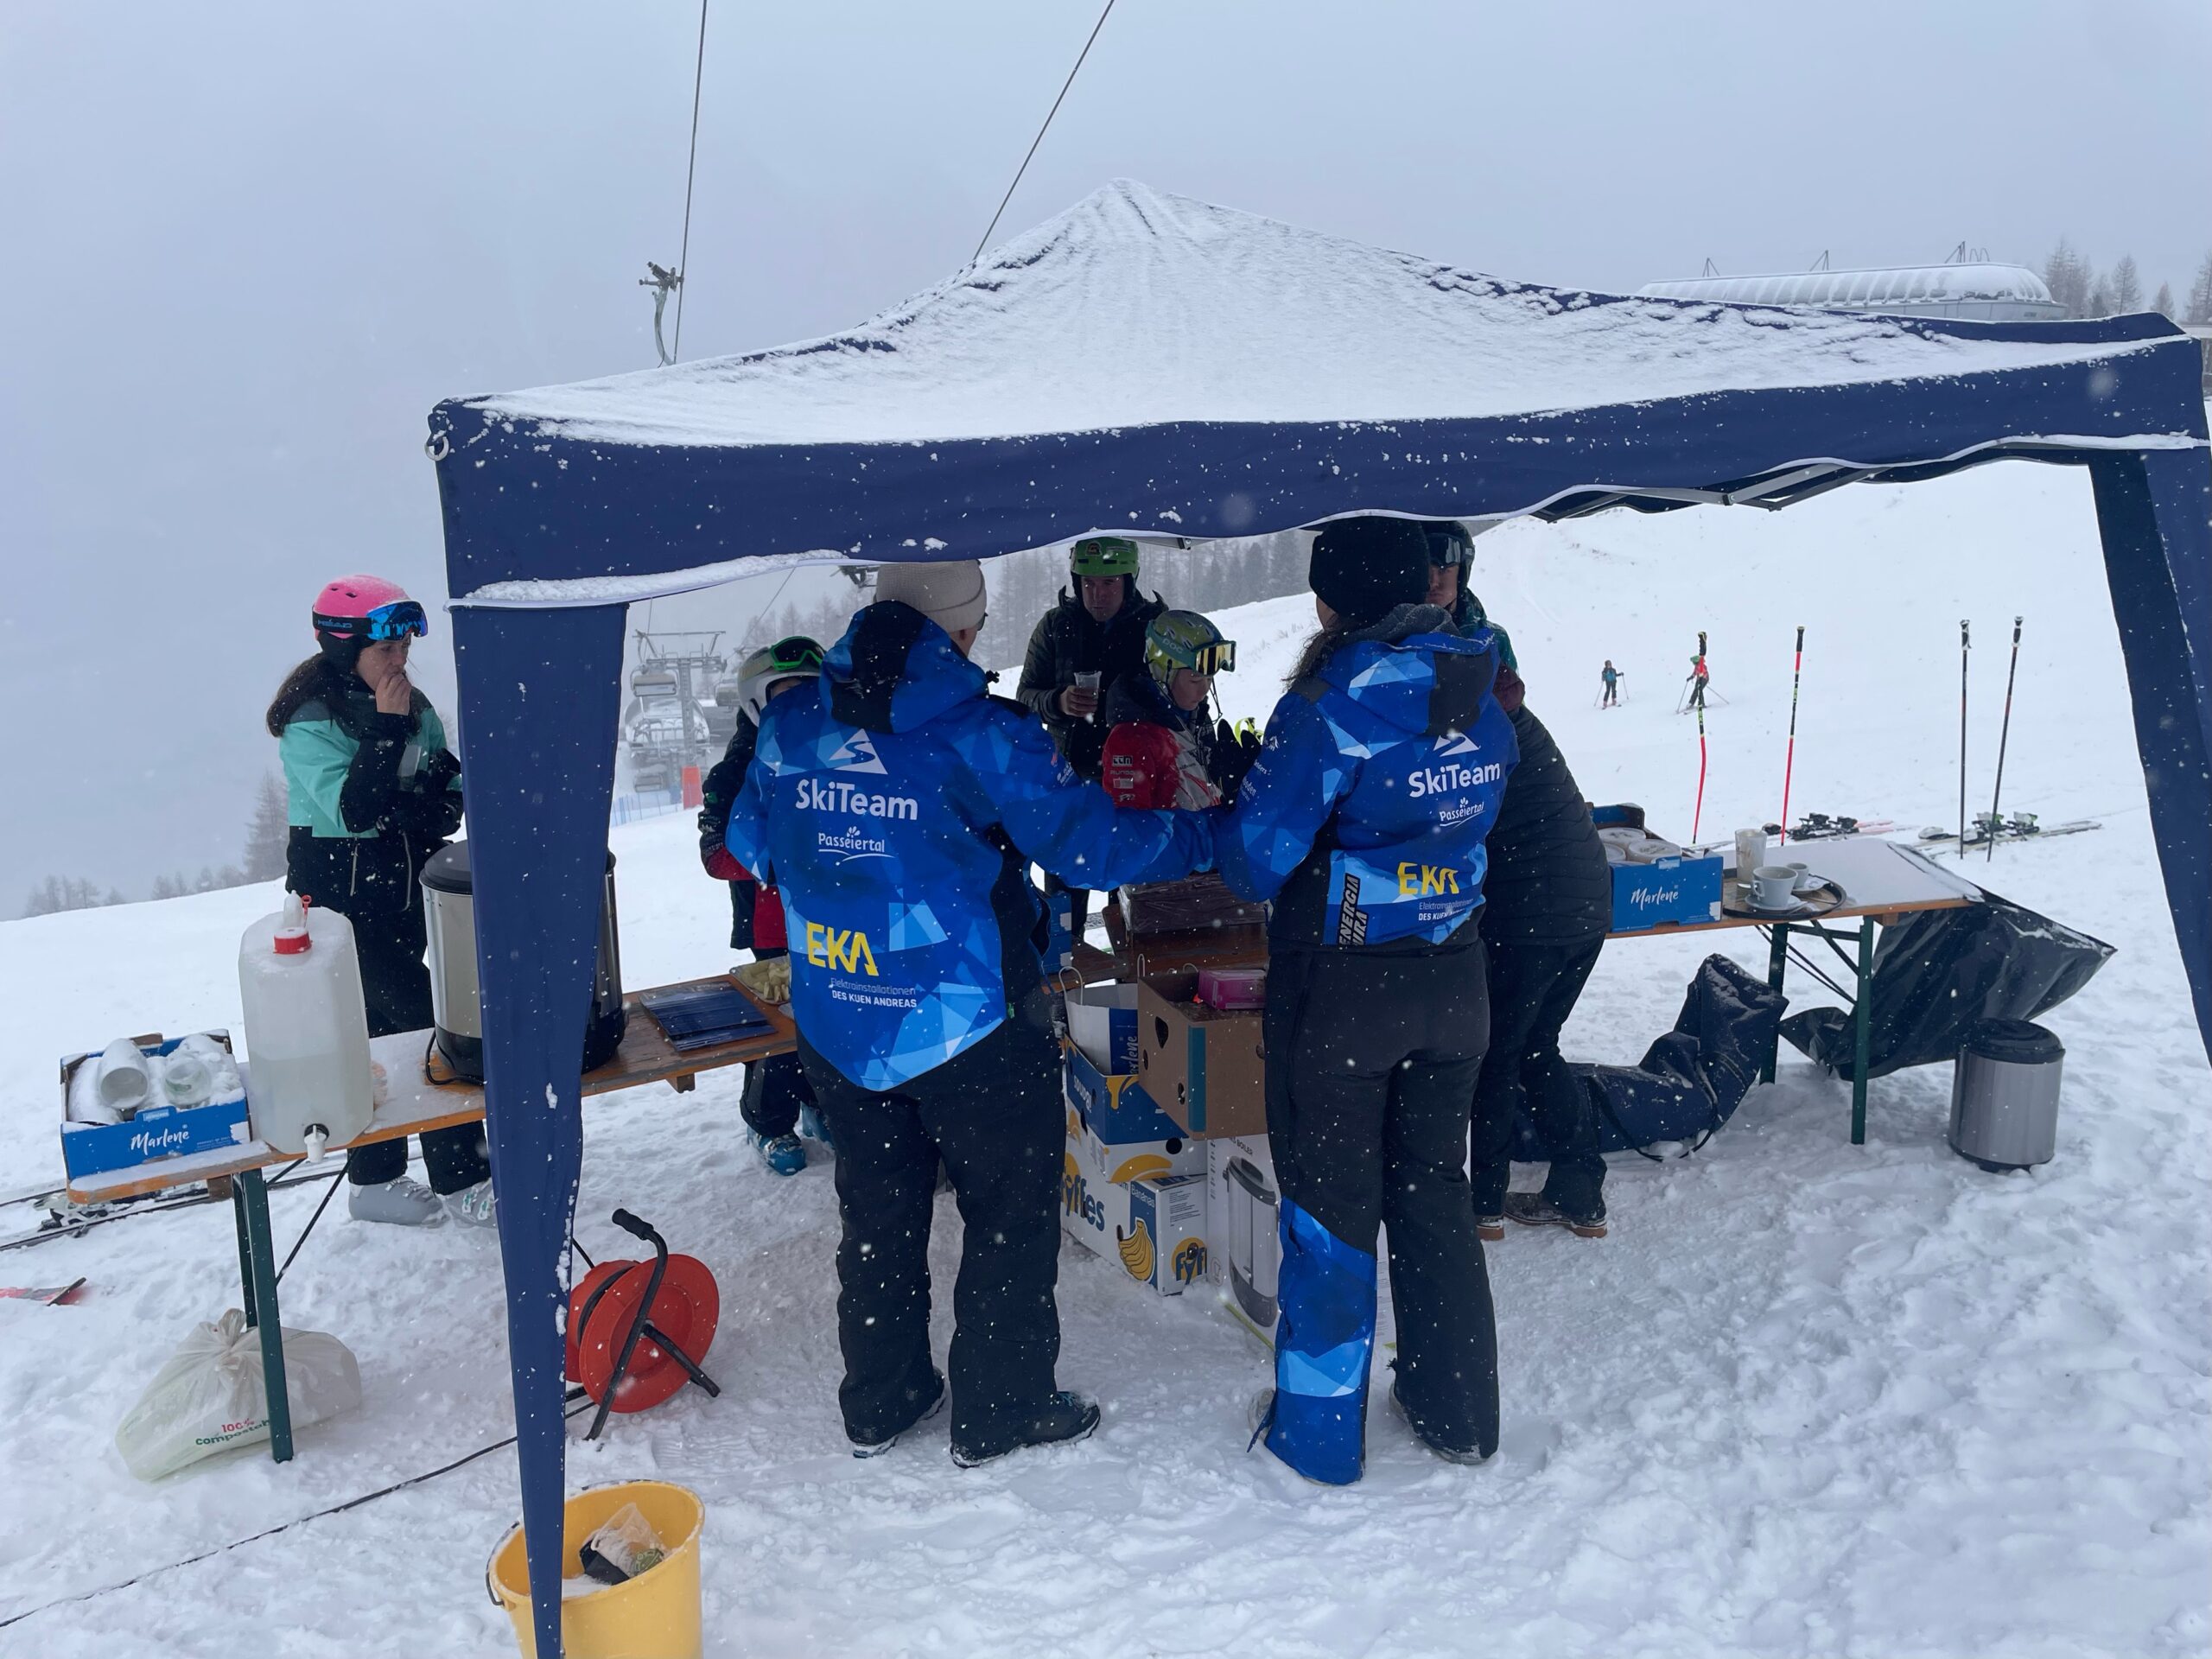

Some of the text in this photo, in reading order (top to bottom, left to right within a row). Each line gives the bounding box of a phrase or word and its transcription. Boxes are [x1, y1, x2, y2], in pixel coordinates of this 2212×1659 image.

[1408, 763, 1501, 798] SkiTeam
[795, 778, 918, 820] SkiTeam
[1439, 801, 1484, 822] Passeiertal
[817, 831, 886, 853] Passeiertal
[1630, 886, 1679, 912] Marlene
[1418, 912, 1432, 921] DES
[806, 921, 880, 976] EKA
[830, 977, 916, 995] Elektroinstallationen
[831, 989, 918, 1008] DES KUEN ANDREAS
[1120, 1035, 1139, 1075] arlene
[130, 1128, 190, 1156] Marlene
[195, 1420, 270, 1446] compostab
[221, 1418, 255, 1433] 100%
